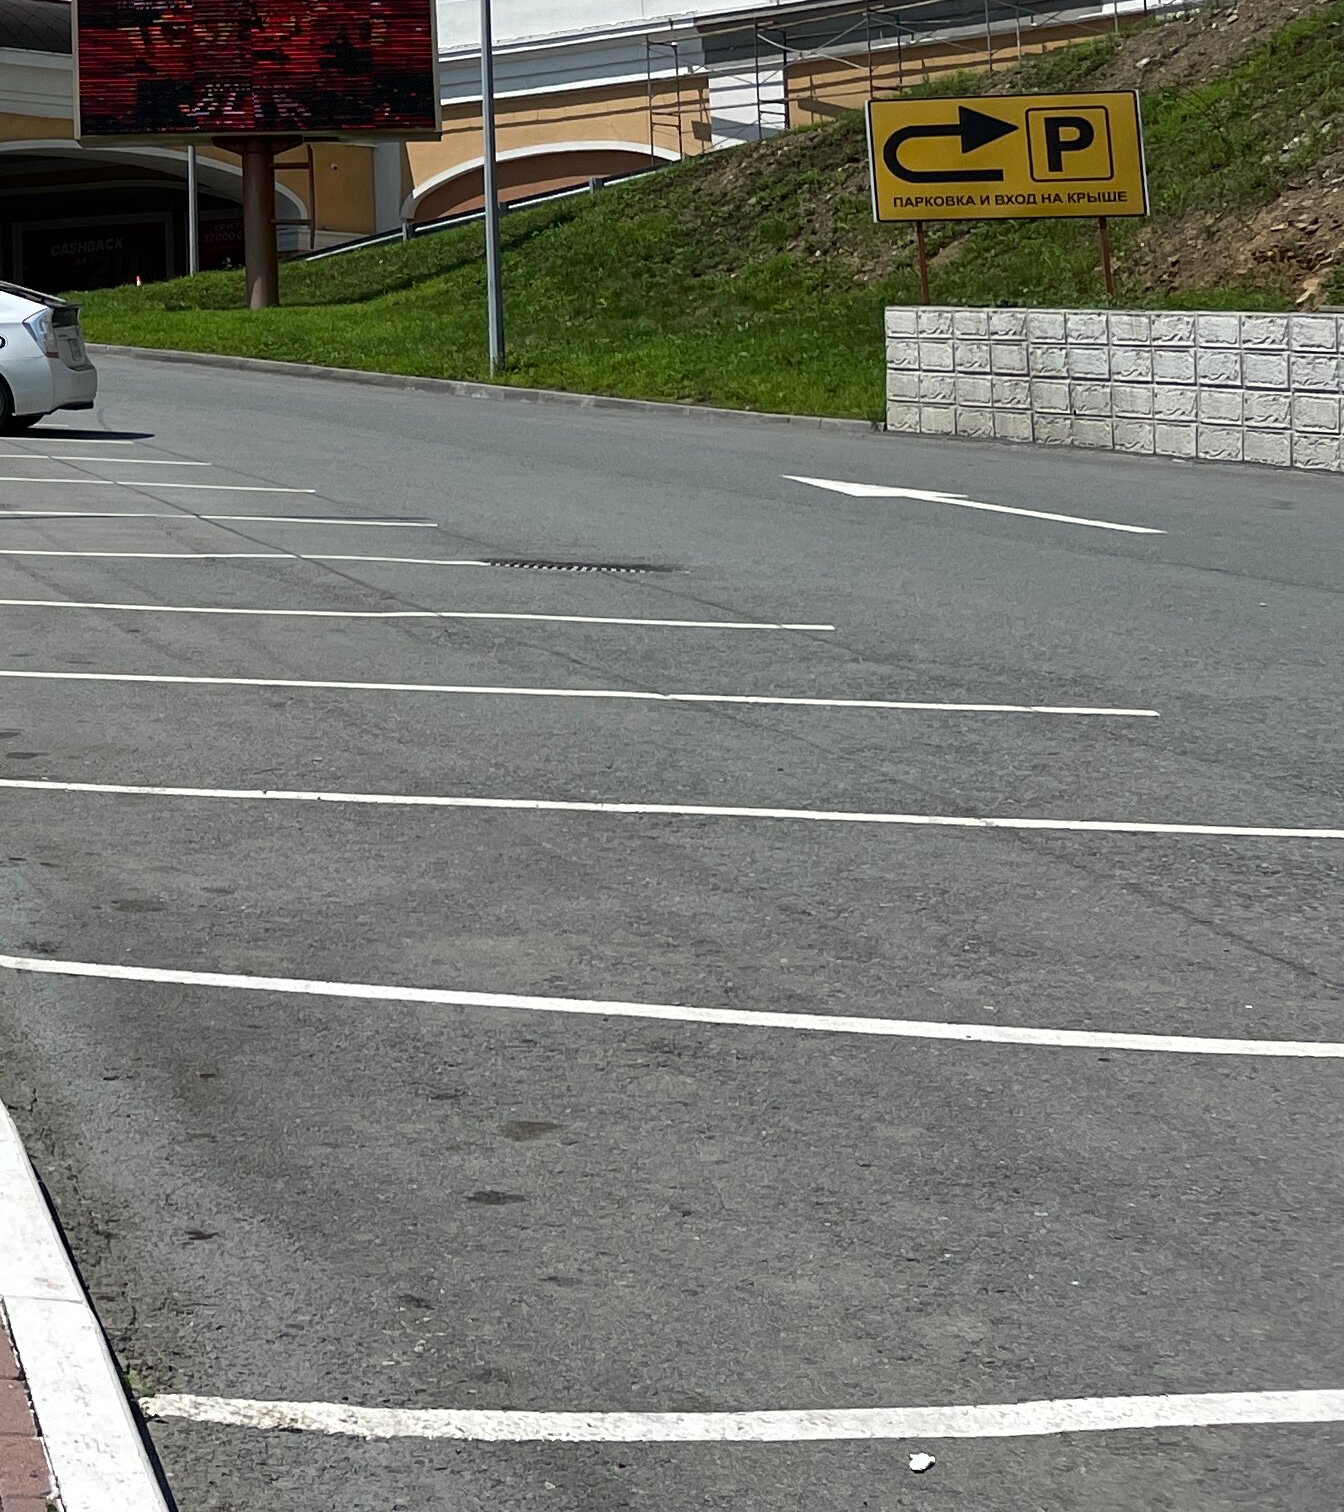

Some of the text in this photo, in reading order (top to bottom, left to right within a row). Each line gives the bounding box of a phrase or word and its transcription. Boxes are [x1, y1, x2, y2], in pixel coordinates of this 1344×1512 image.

[1043, 116, 1095, 172] P
[893, 191, 1128, 208] ПАРКОВКА И ВХОД НА КРЫШЕ
[50, 236, 125, 257] CASHBACK
